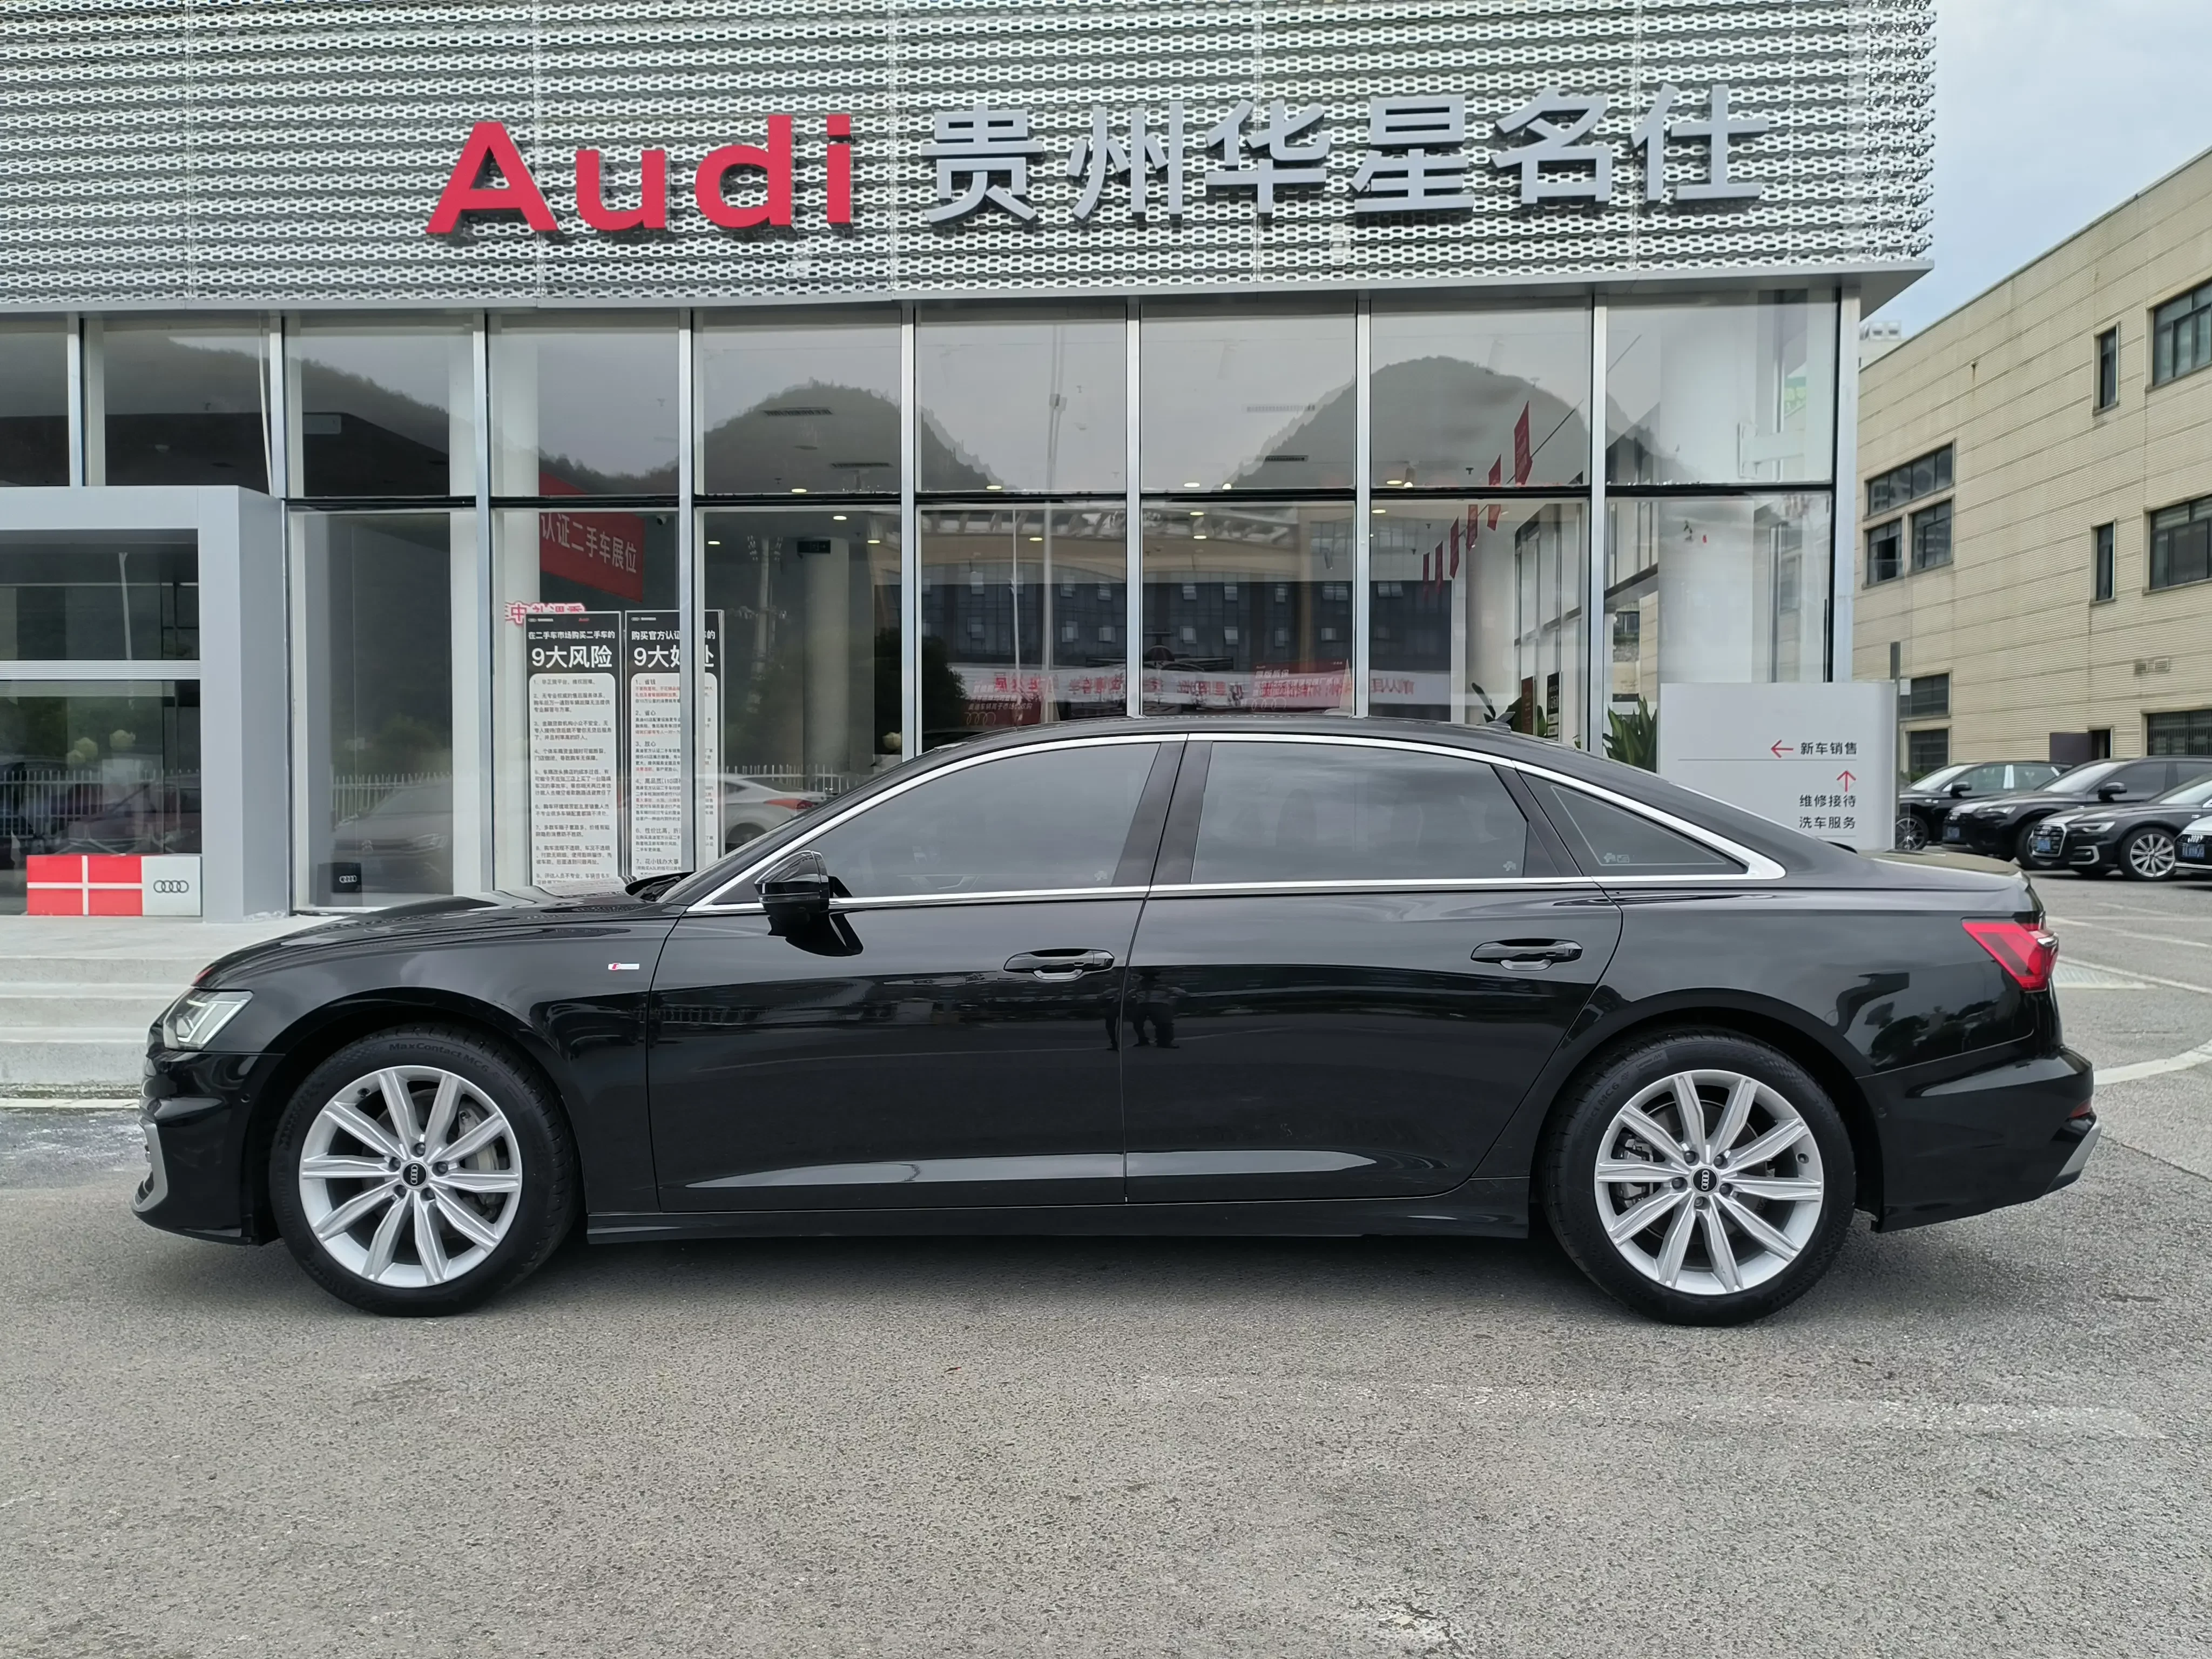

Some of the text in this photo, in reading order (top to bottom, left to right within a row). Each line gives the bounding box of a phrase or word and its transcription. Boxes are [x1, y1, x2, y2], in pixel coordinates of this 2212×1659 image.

[426, 83, 1770, 233] Audi 贵州华星名仕
[541, 512, 637, 574] 认证二手车展位
[528, 630, 616, 639] 在二手车市场购买二手车的
[631, 630, 716, 640] 购买官方认证的
[531, 645, 612, 669] 9大风险
[1799, 741, 1858, 756] 新车销售
[1799, 794, 1857, 808] 维修接待
[1799, 816, 1857, 830] 洗车服务
[389, 1042, 489, 1073] MaxContact MC6
[1597, 1082, 1620, 1106] MC6
